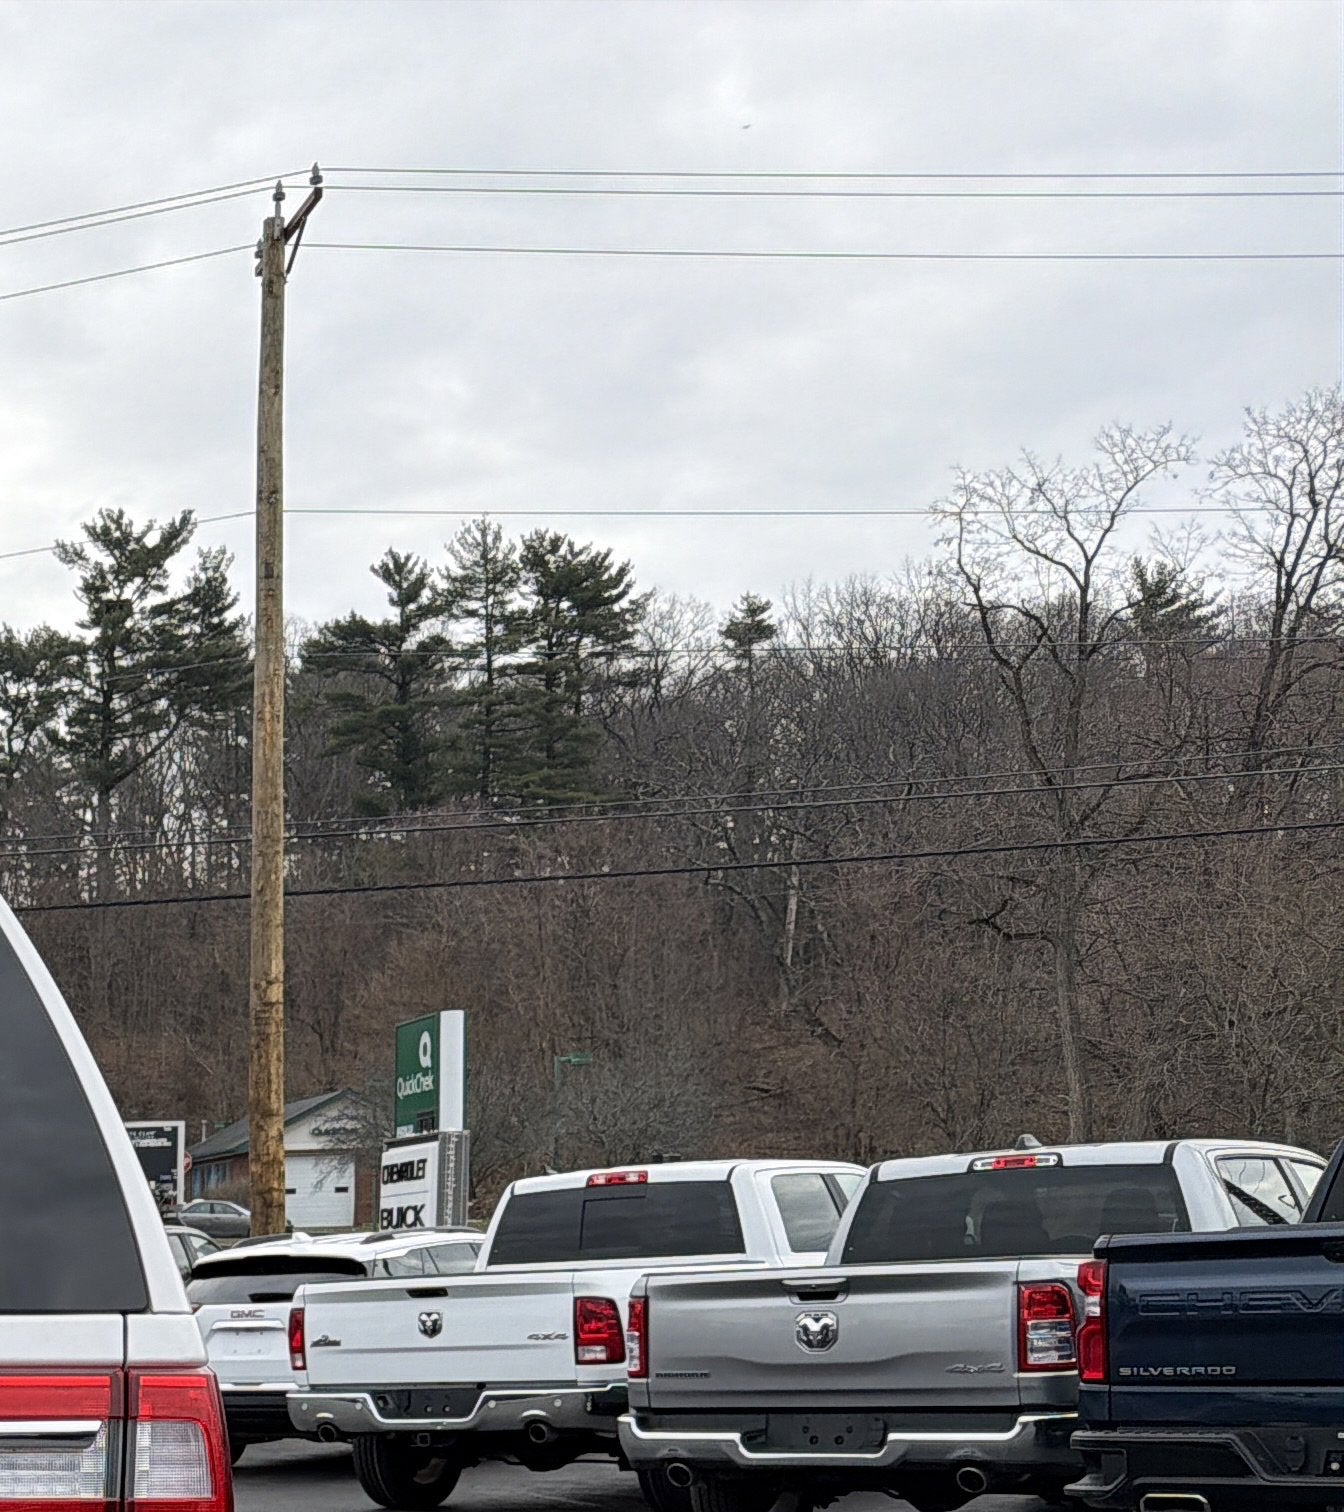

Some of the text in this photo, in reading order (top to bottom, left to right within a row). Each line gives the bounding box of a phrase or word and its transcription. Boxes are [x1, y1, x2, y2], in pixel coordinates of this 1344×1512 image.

[381, 1204, 426, 1229] BUICK
[231, 1309, 265, 1319] GMC
[1119, 1366, 1236, 1376] SILVERADO
